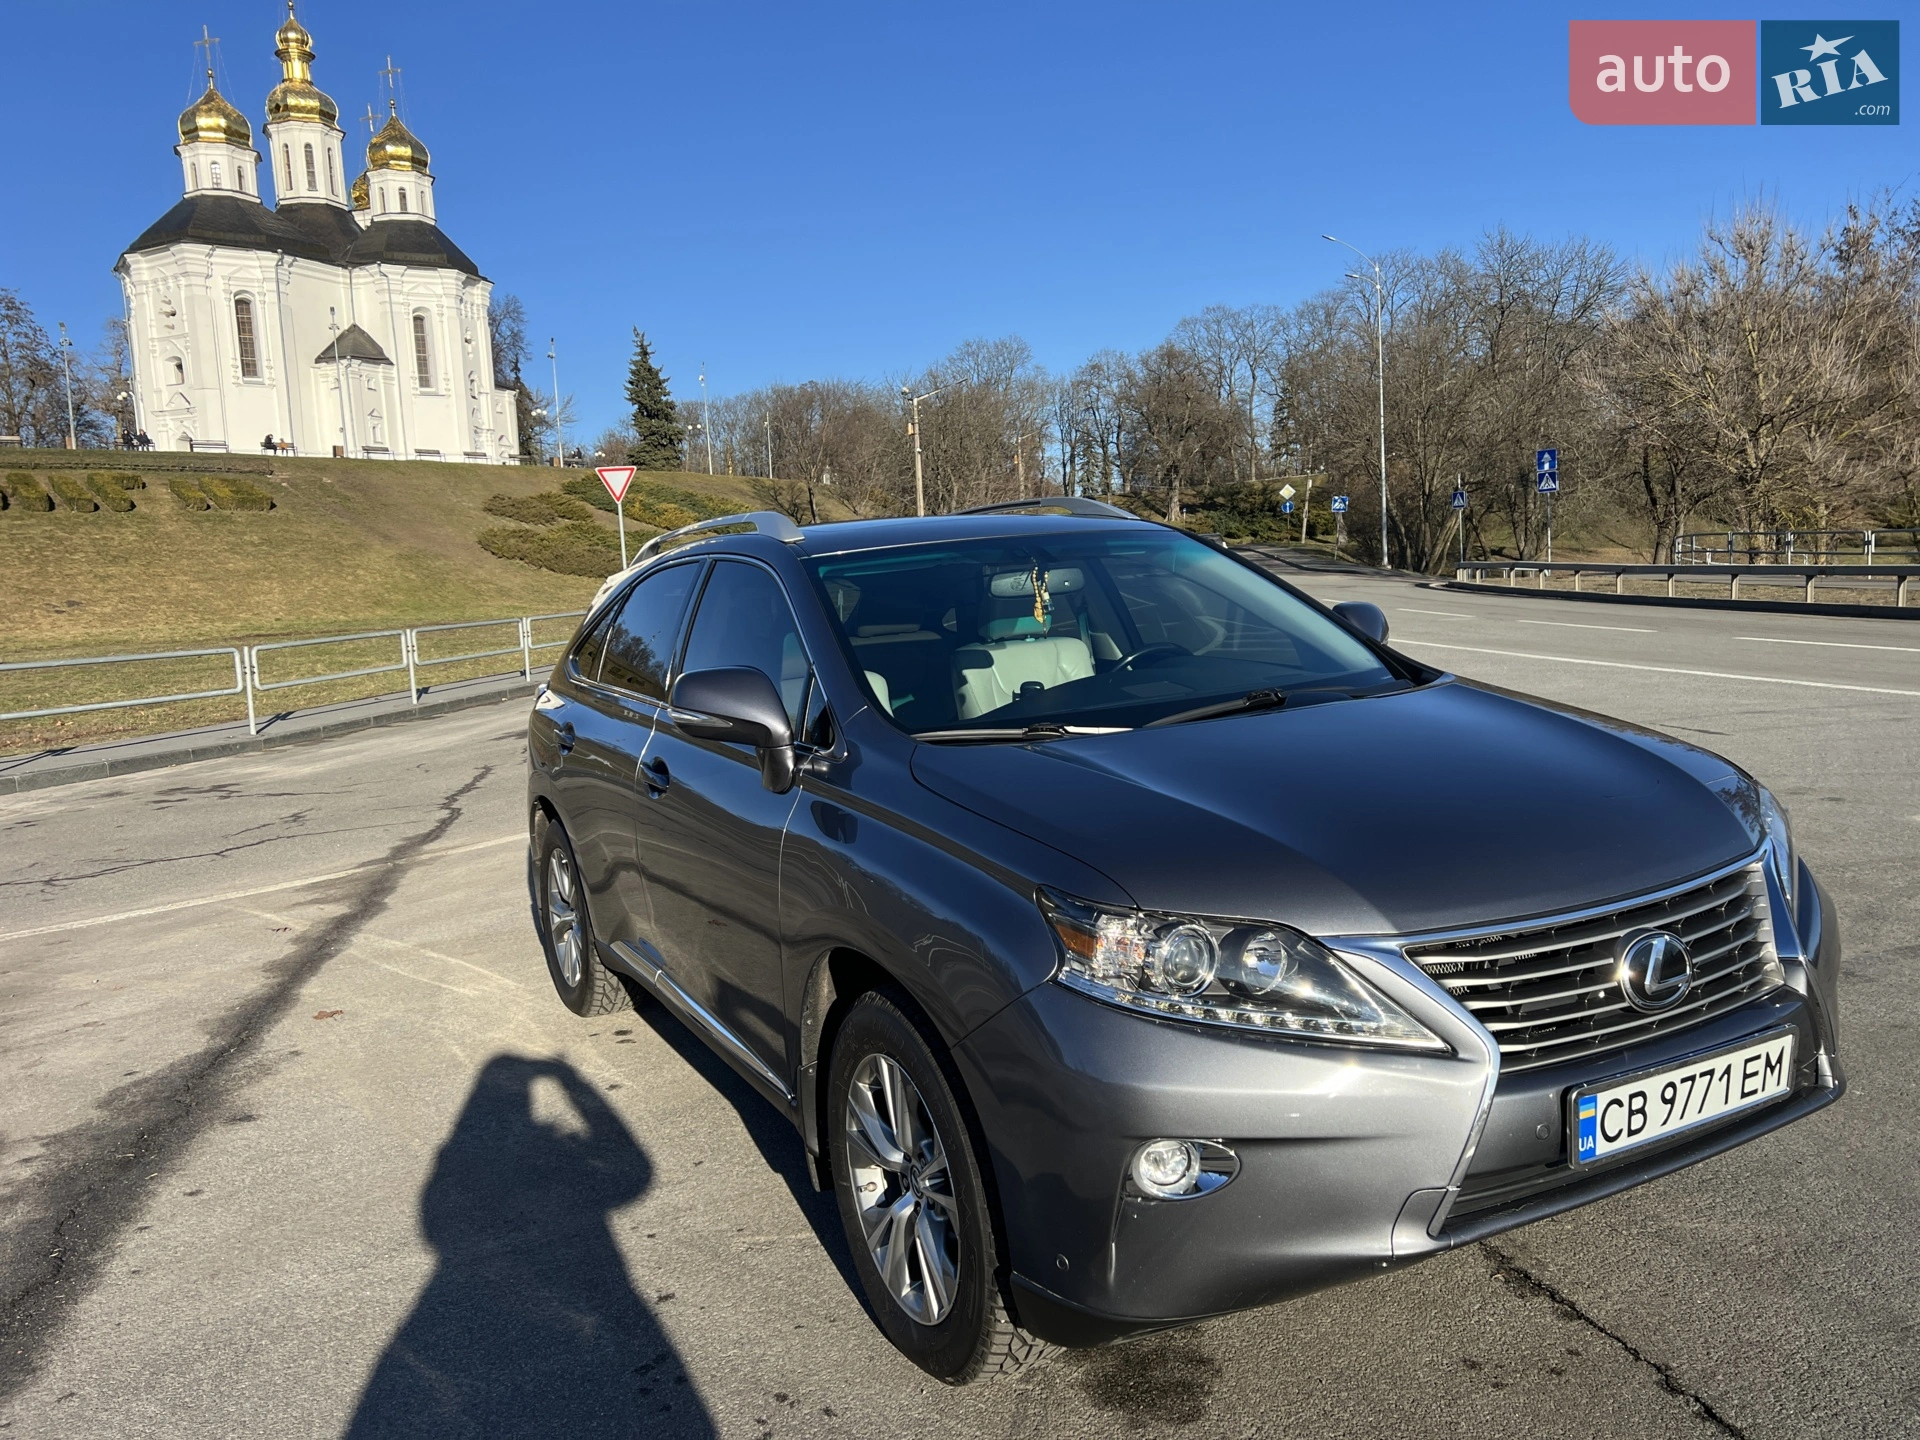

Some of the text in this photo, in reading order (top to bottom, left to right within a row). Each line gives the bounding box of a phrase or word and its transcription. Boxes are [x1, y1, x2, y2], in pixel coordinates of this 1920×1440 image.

[1600, 1045, 1786, 1143] CB 9771 EM
[1579, 1136, 1595, 1152] UA
